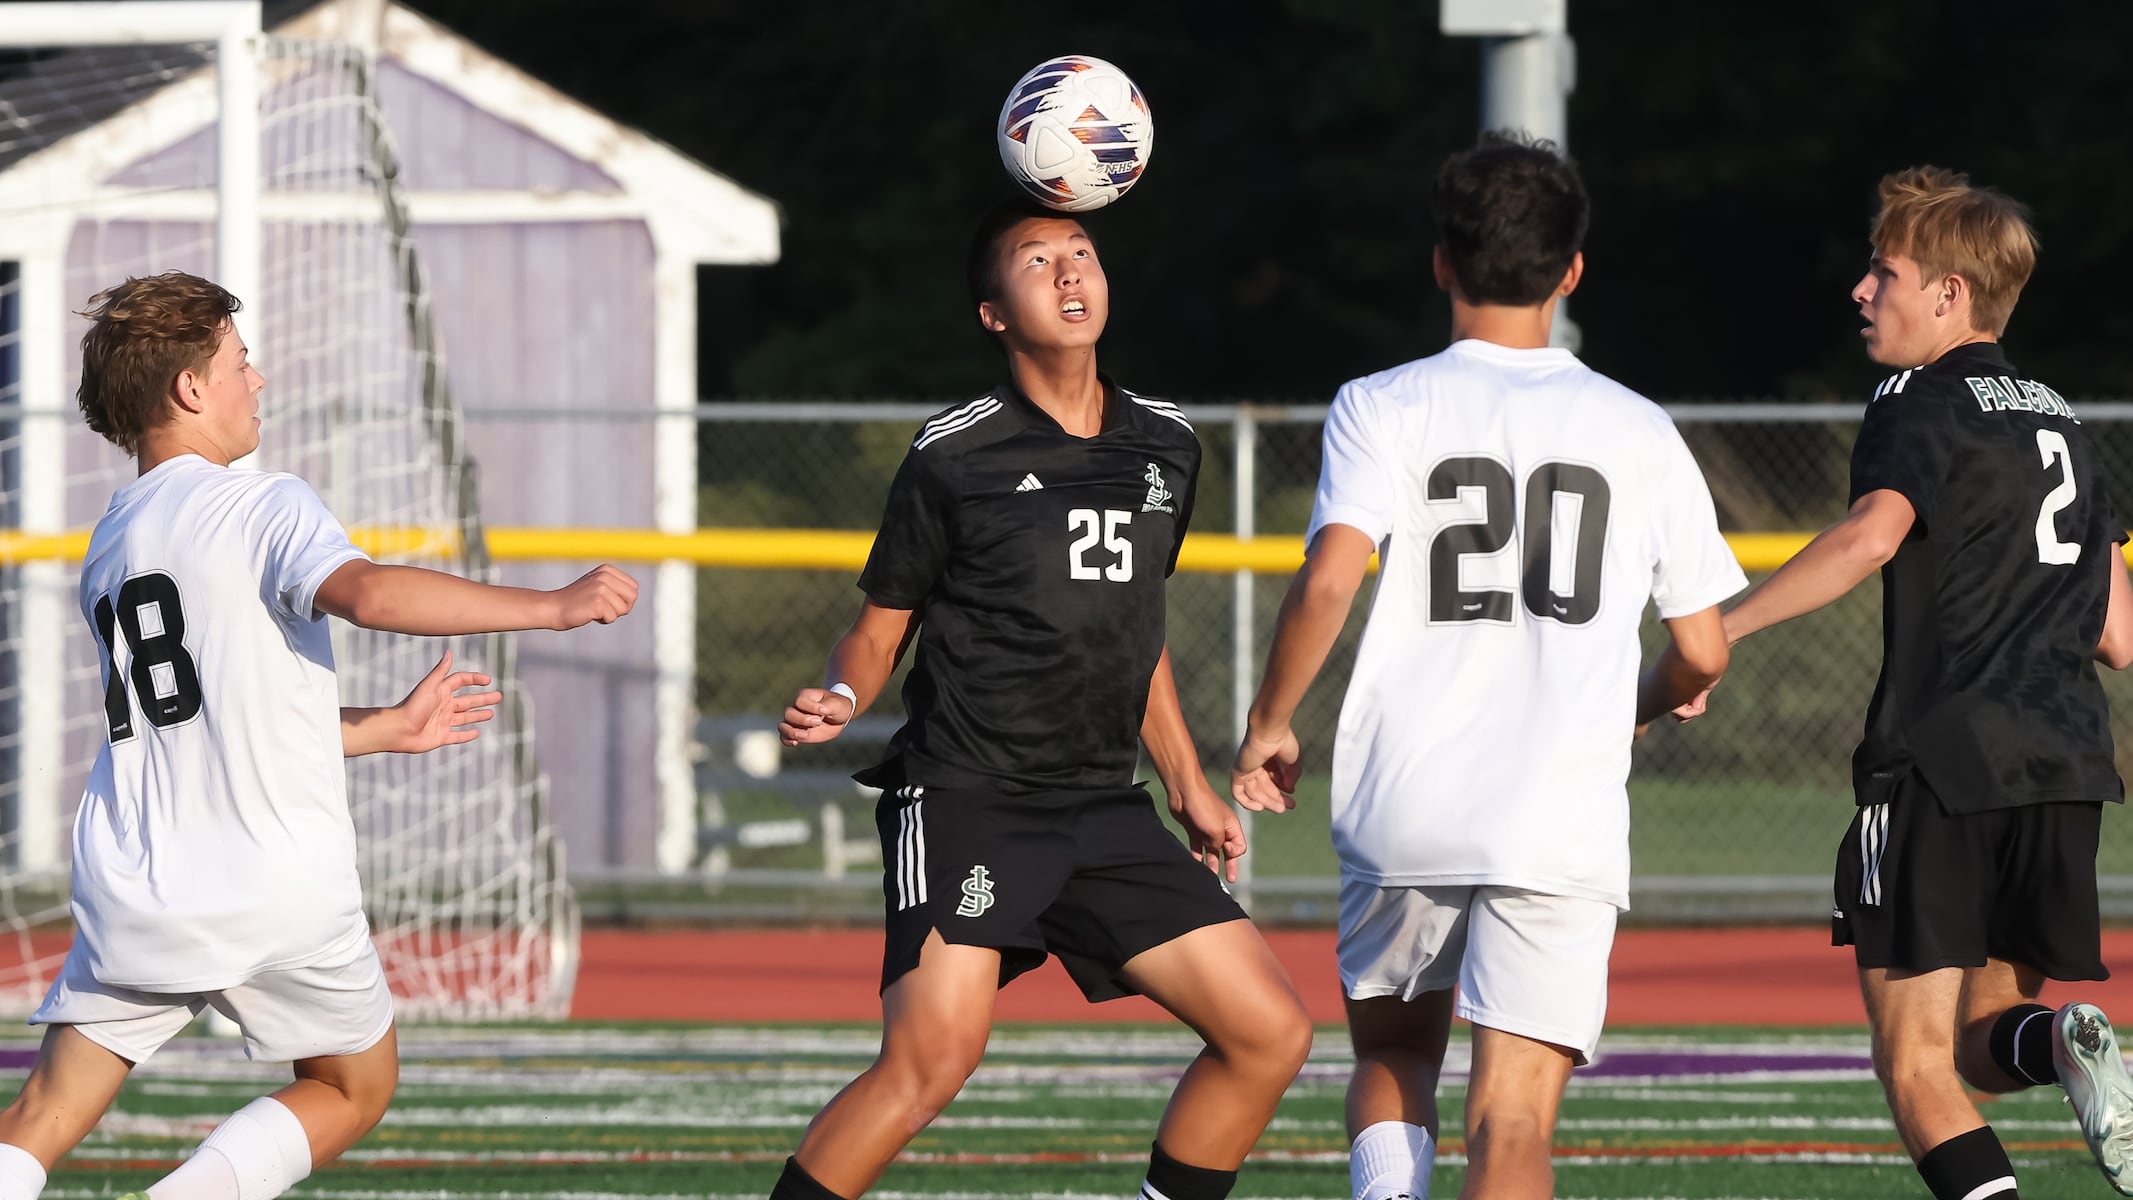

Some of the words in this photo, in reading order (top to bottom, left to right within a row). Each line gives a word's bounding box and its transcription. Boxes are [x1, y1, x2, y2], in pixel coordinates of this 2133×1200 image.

[1104, 161, 1133, 173] NFHS
[1965, 376, 2081, 425] FALCON
[1068, 508, 1133, 582] 25
[1424, 452, 1612, 628] 20
[2035, 428, 2082, 565] 2
[93, 568, 203, 747] 18
